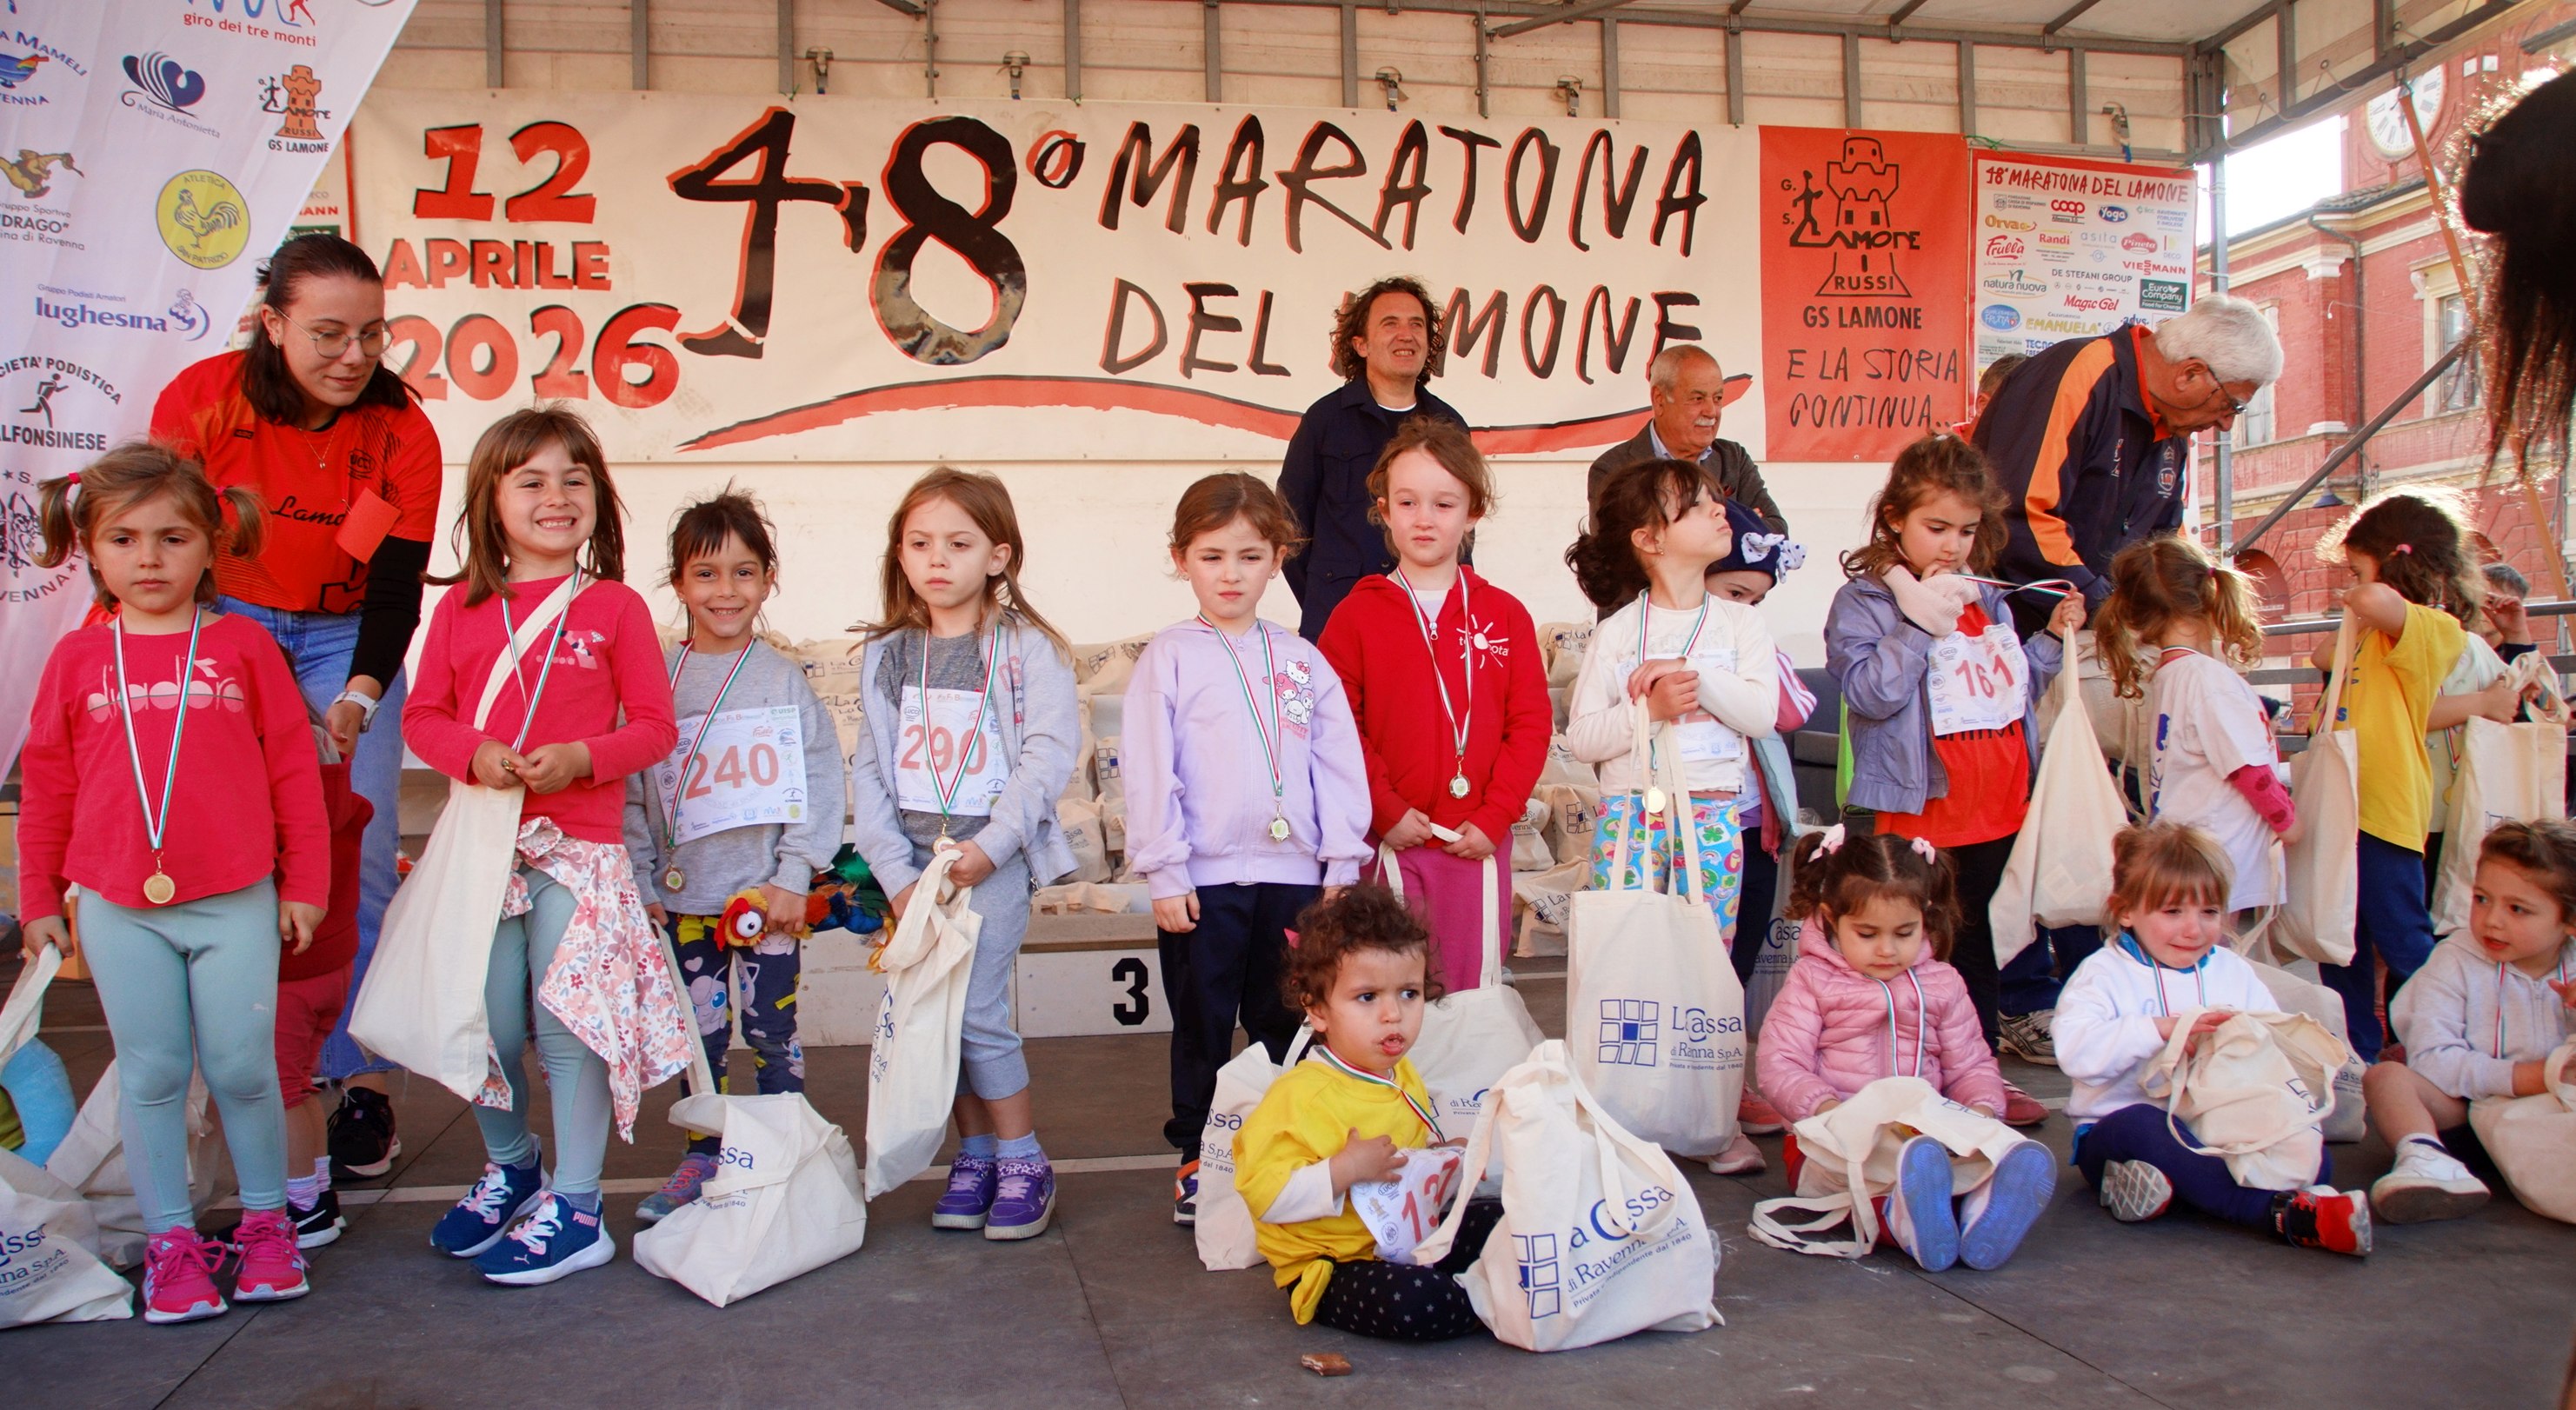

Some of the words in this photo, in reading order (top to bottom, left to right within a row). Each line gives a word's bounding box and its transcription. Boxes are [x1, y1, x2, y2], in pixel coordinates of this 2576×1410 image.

[183, 13, 213, 26] giro
[218, 19, 242, 33] dei
[247, 24, 270, 38] tre
[274, 31, 316, 47] monti
[268, 139, 283, 150] GS
[286, 142, 329, 153] LAMONE
[413, 120, 598, 225] 12
[1099, 112, 1707, 258] MARATONA
[2008, 169, 2087, 194] MARATONA
[2091, 176, 2122, 196] DEL
[2127, 180, 2188, 203] LAMONE
[0, 203, 30, 212] ruppo
[23, 231, 34, 241] di
[38, 233, 85, 250] Ravenna
[2039, 233, 2070, 244] Randi
[383, 238, 612, 291] APRILE
[2065, 270, 2100, 280] STEFANI
[2101, 273, 2133, 283] GROUP
[1834, 276, 1895, 290] RUSSI
[1983, 279, 2014, 289] natura
[2016, 283, 2047, 292] nuova
[2142, 289, 2183, 303] Company
[2148, 283, 2168, 292] Euro
[36, 296, 168, 333] lughesina
[1803, 306, 1830, 329] GS
[1838, 306, 1922, 329] LAMONE
[2064, 295, 2097, 311] Magic
[2099, 297, 2120, 311] Gel
[1099, 277, 1291, 380] DEL
[386, 301, 683, 409] 2026
[1787, 349, 1807, 381] E
[1819, 347, 1848, 382] LA
[1864, 348, 1958, 383] STORIA
[46, 356, 122, 405] PODISTICA
[0, 424, 107, 451] LFONSINESE
[1954, 654, 2014, 699] 161
[900, 723, 988, 775] 290
[682, 743, 779, 800] 240
[1112, 957, 1149, 1026] 3
[1215, 1164, 1234, 1174] 1840
[573, 1211, 598, 1227] PUMA
[1590, 1186, 1674, 1241] Cssa
[1573, 1288, 1601, 1307] Privata
[1656, 1244, 1669, 1254] dal
[1672, 1234, 1692, 1247] 1840
